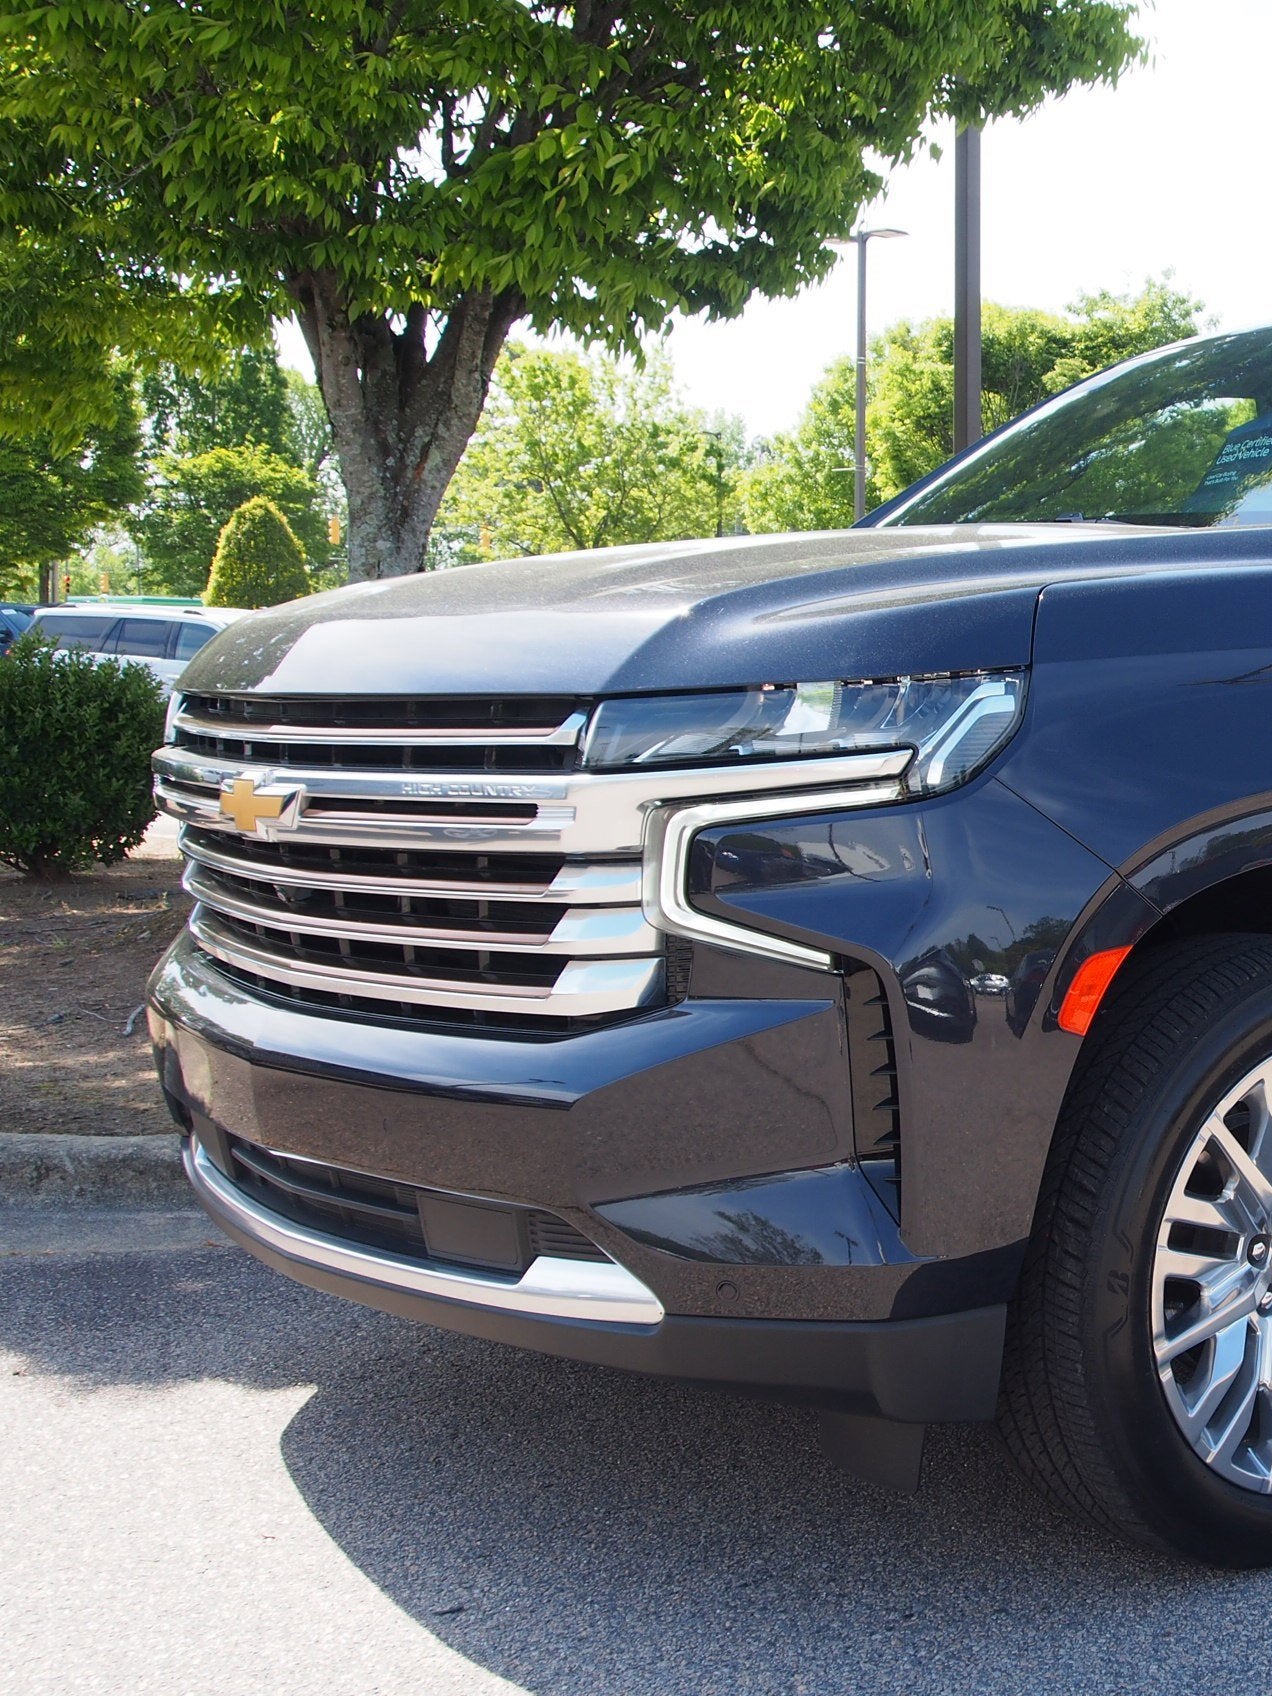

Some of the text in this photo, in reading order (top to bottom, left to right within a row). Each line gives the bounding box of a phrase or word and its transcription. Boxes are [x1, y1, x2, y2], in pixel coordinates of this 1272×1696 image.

[1221, 443, 1241, 455] Blue
[1216, 447, 1270, 465] Used Vehicle
[401, 783, 537, 796] HIGH COUNTRY
